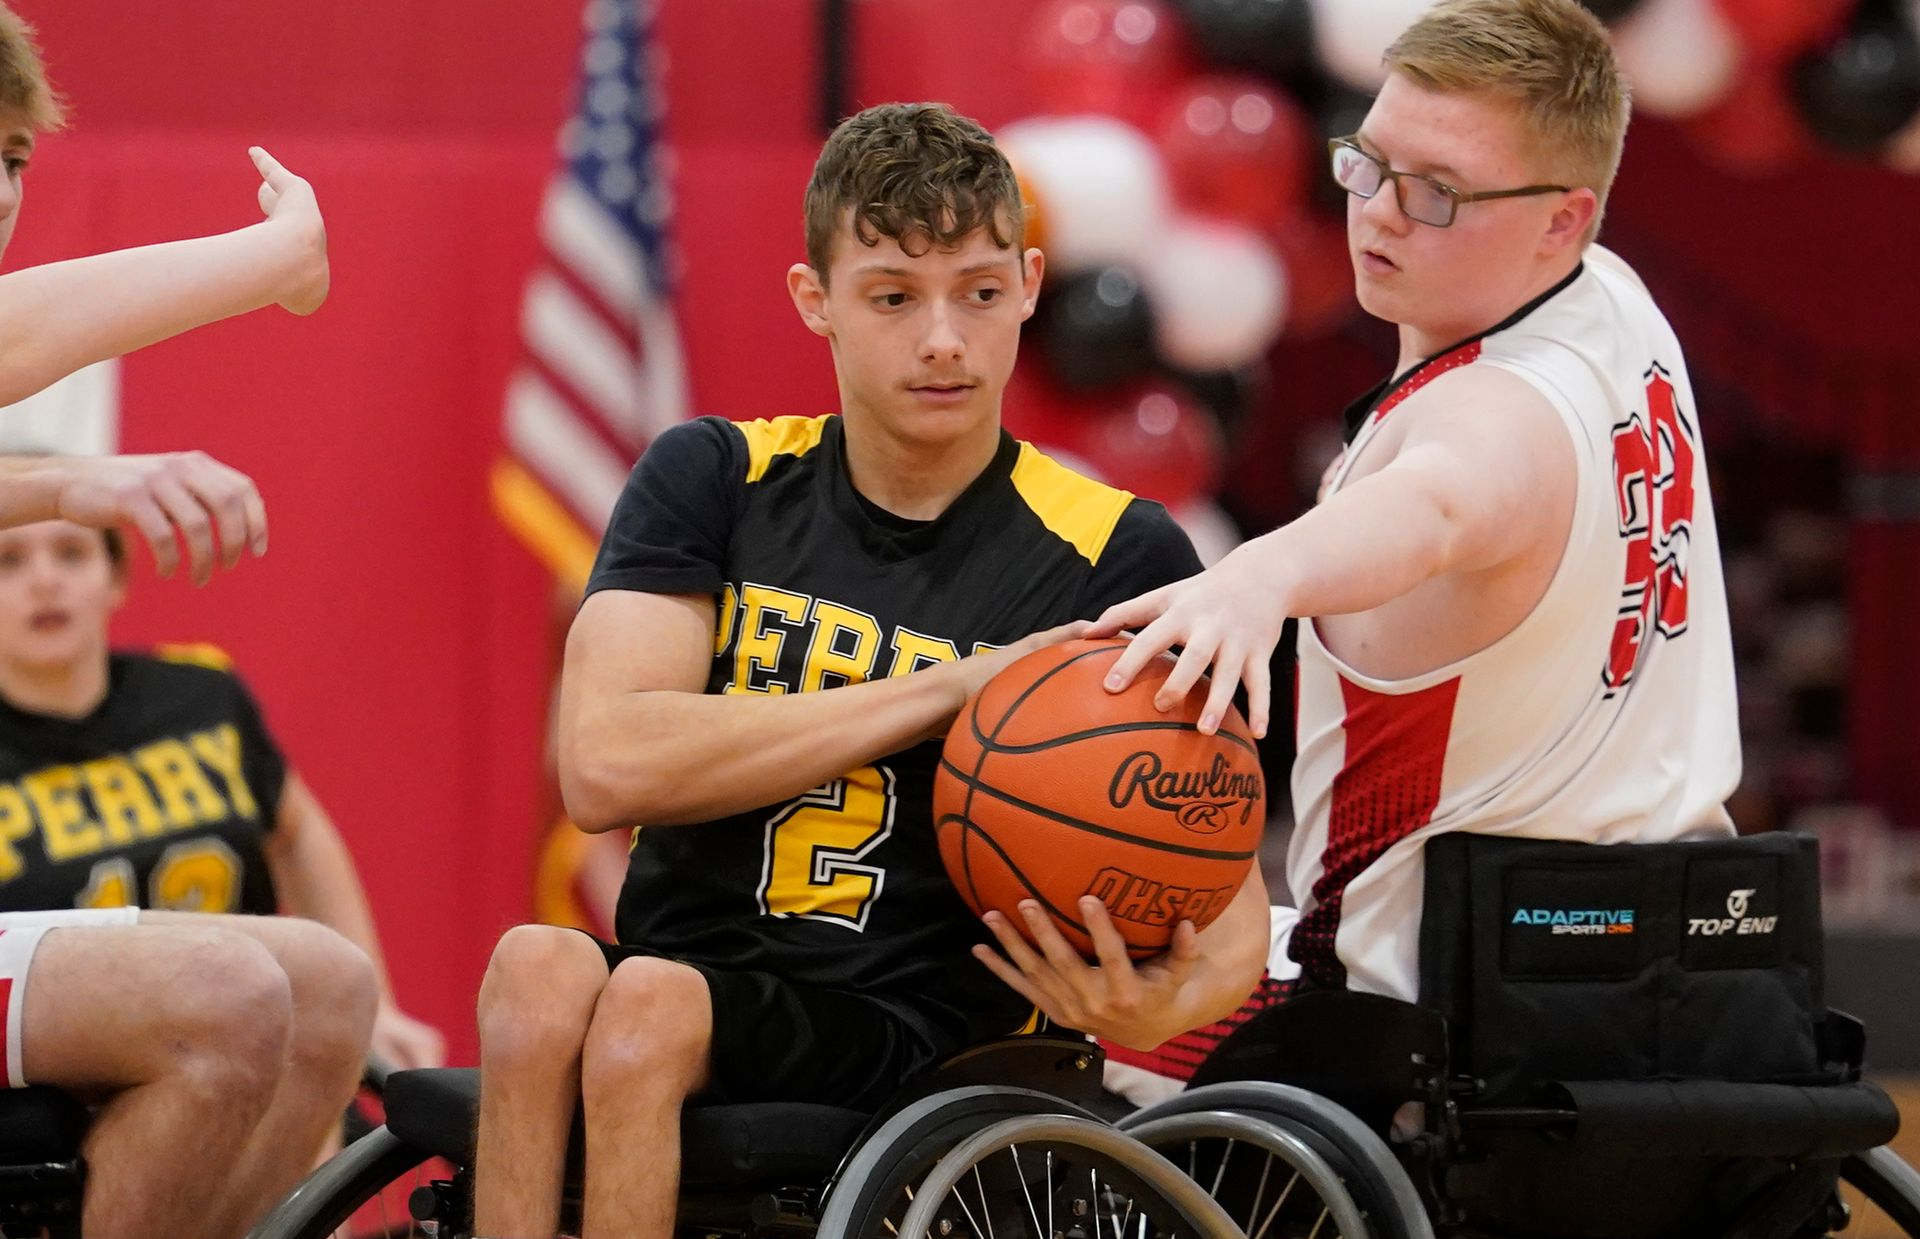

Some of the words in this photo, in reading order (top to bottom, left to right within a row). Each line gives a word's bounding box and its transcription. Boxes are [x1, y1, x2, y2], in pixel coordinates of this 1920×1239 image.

[756, 766, 897, 933] 2
[1512, 908, 1634, 926] ADAPTIVE
[1687, 918, 1736, 936] TOP
[1736, 915, 1778, 935] END
[1551, 924, 1605, 935] SPORTS
